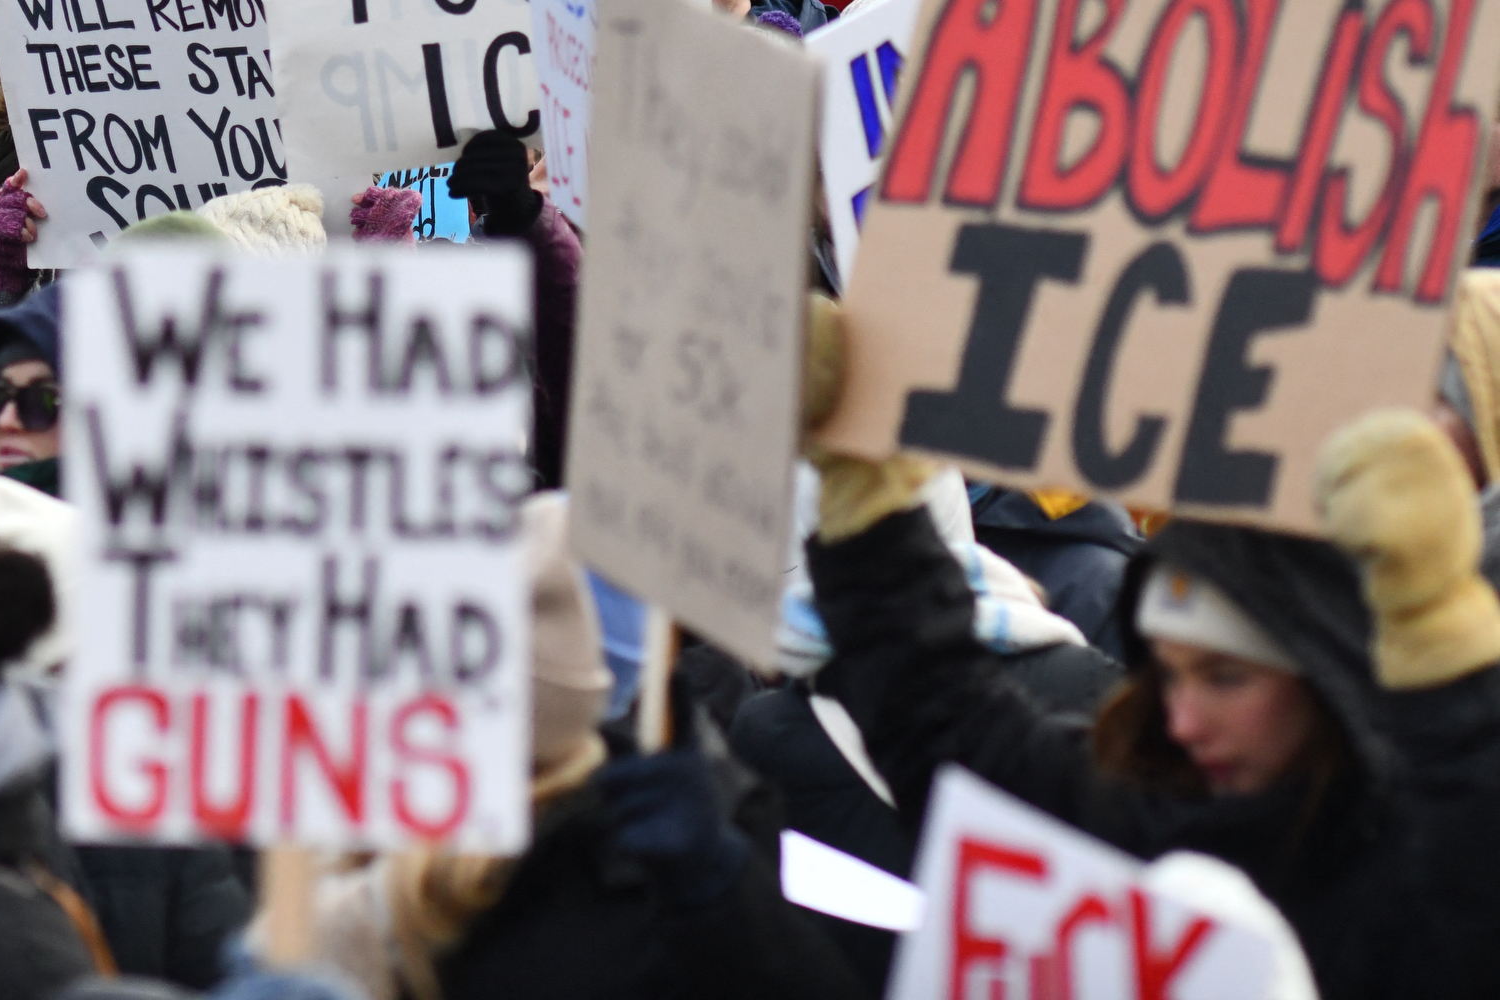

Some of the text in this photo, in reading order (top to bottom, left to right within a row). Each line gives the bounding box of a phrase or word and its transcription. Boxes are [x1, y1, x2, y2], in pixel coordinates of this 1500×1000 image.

[25, 42, 276, 100] THESE STA
[28, 108, 177, 175] FROM
[111, 264, 270, 394] WE
[320, 268, 533, 397] HAD
[899, 222, 1321, 510] ICE
[86, 405, 531, 545] WHISTLES
[91, 546, 506, 684] THEY HAD
[86, 684, 472, 841] GUNS
[950, 836, 1218, 1000] FCK
